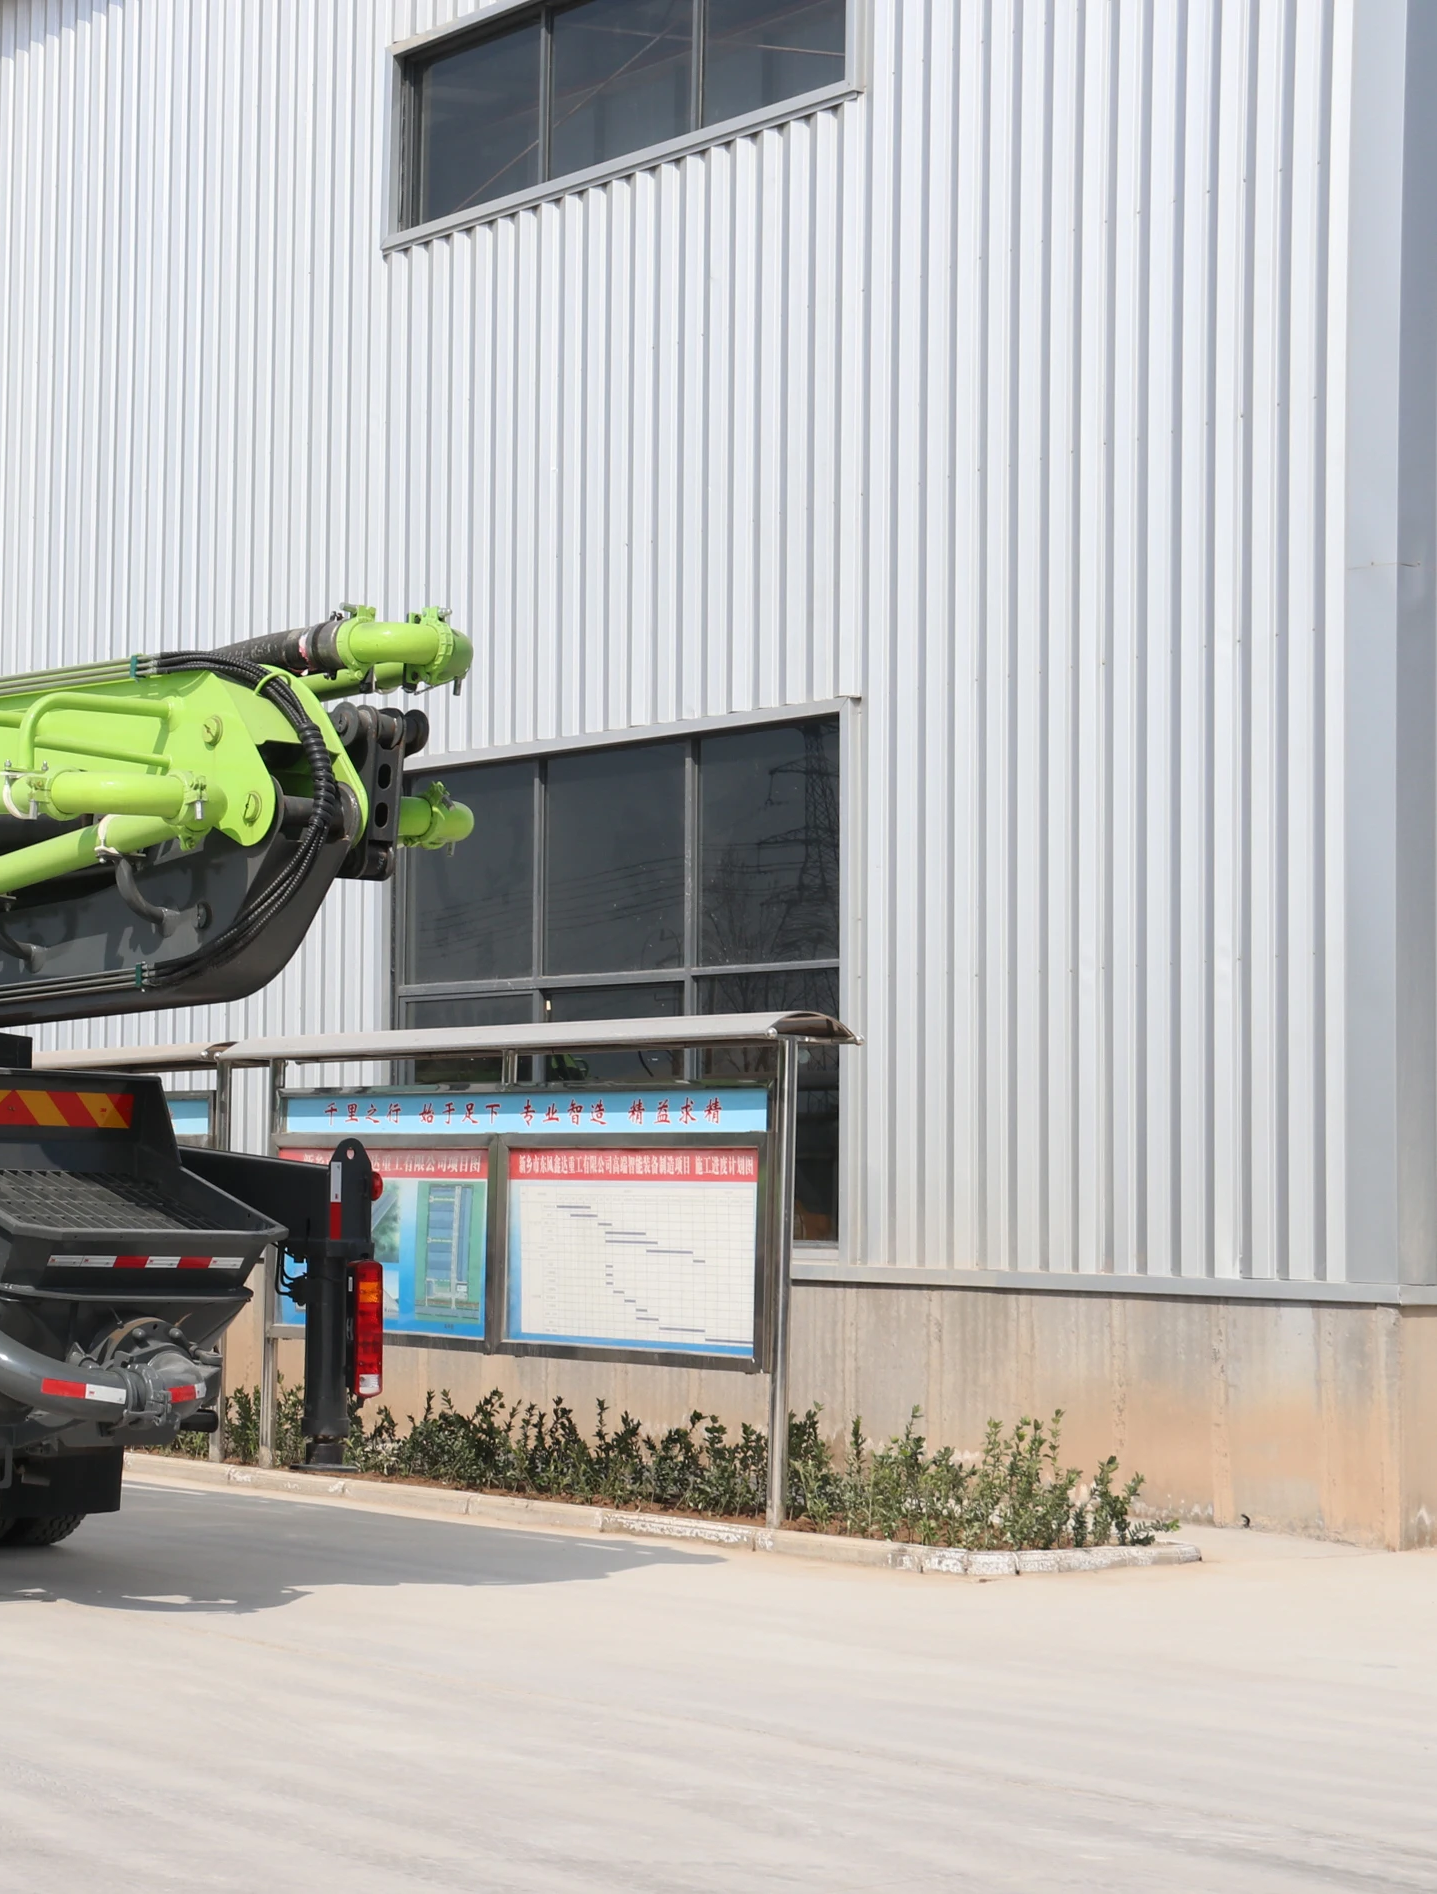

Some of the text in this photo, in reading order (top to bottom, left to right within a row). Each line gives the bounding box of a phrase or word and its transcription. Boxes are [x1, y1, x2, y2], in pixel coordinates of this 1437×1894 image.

[324, 1097, 722, 1126] 千里之行 始于足下 专业智造 精益求精
